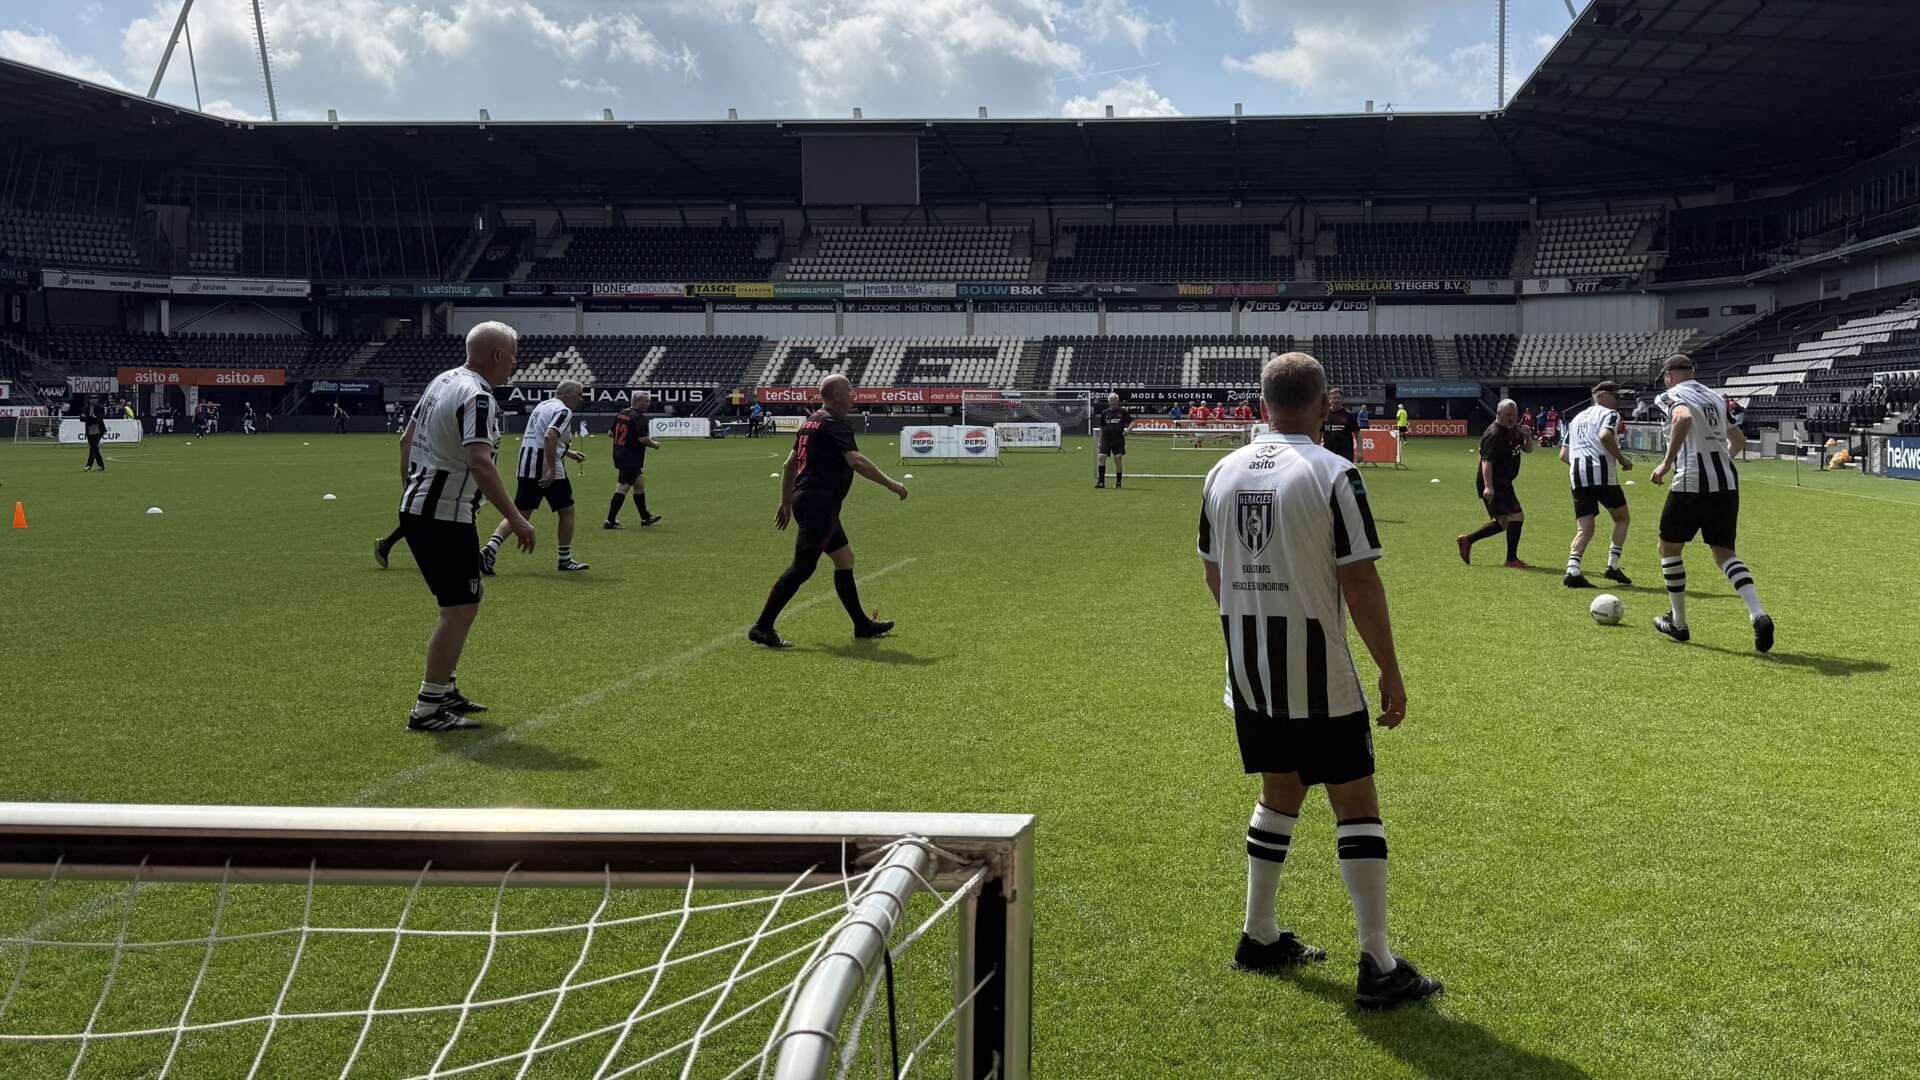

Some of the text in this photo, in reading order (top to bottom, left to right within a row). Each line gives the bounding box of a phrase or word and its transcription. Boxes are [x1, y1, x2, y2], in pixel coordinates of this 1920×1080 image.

[959, 286, 1008, 295] BOUW
[1010, 286, 1044, 295] B&K
[1334, 281, 1463, 291] WINSELAAR STEIGERS B.V.
[858, 303, 901, 313] Landgoed
[905, 303, 919, 311] Het
[1062, 302, 1095, 312] ALMELO
[1256, 302, 1281, 311] DFDS
[1300, 302, 1325, 311] DFDS
[1343, 302, 1369, 311] DFDS
[135, 371, 166, 383] asito
[216, 371, 249, 383] asito
[74, 377, 111, 391] Riwald
[508, 387, 703, 402] AUT HAAHUIS
[766, 391, 806, 401] terStal
[882, 390, 924, 401] terStal
[1416, 420, 1465, 433] schoon
[1249, 458, 1275, 470] asito
[1239, 494, 1273, 505] HERACLES
